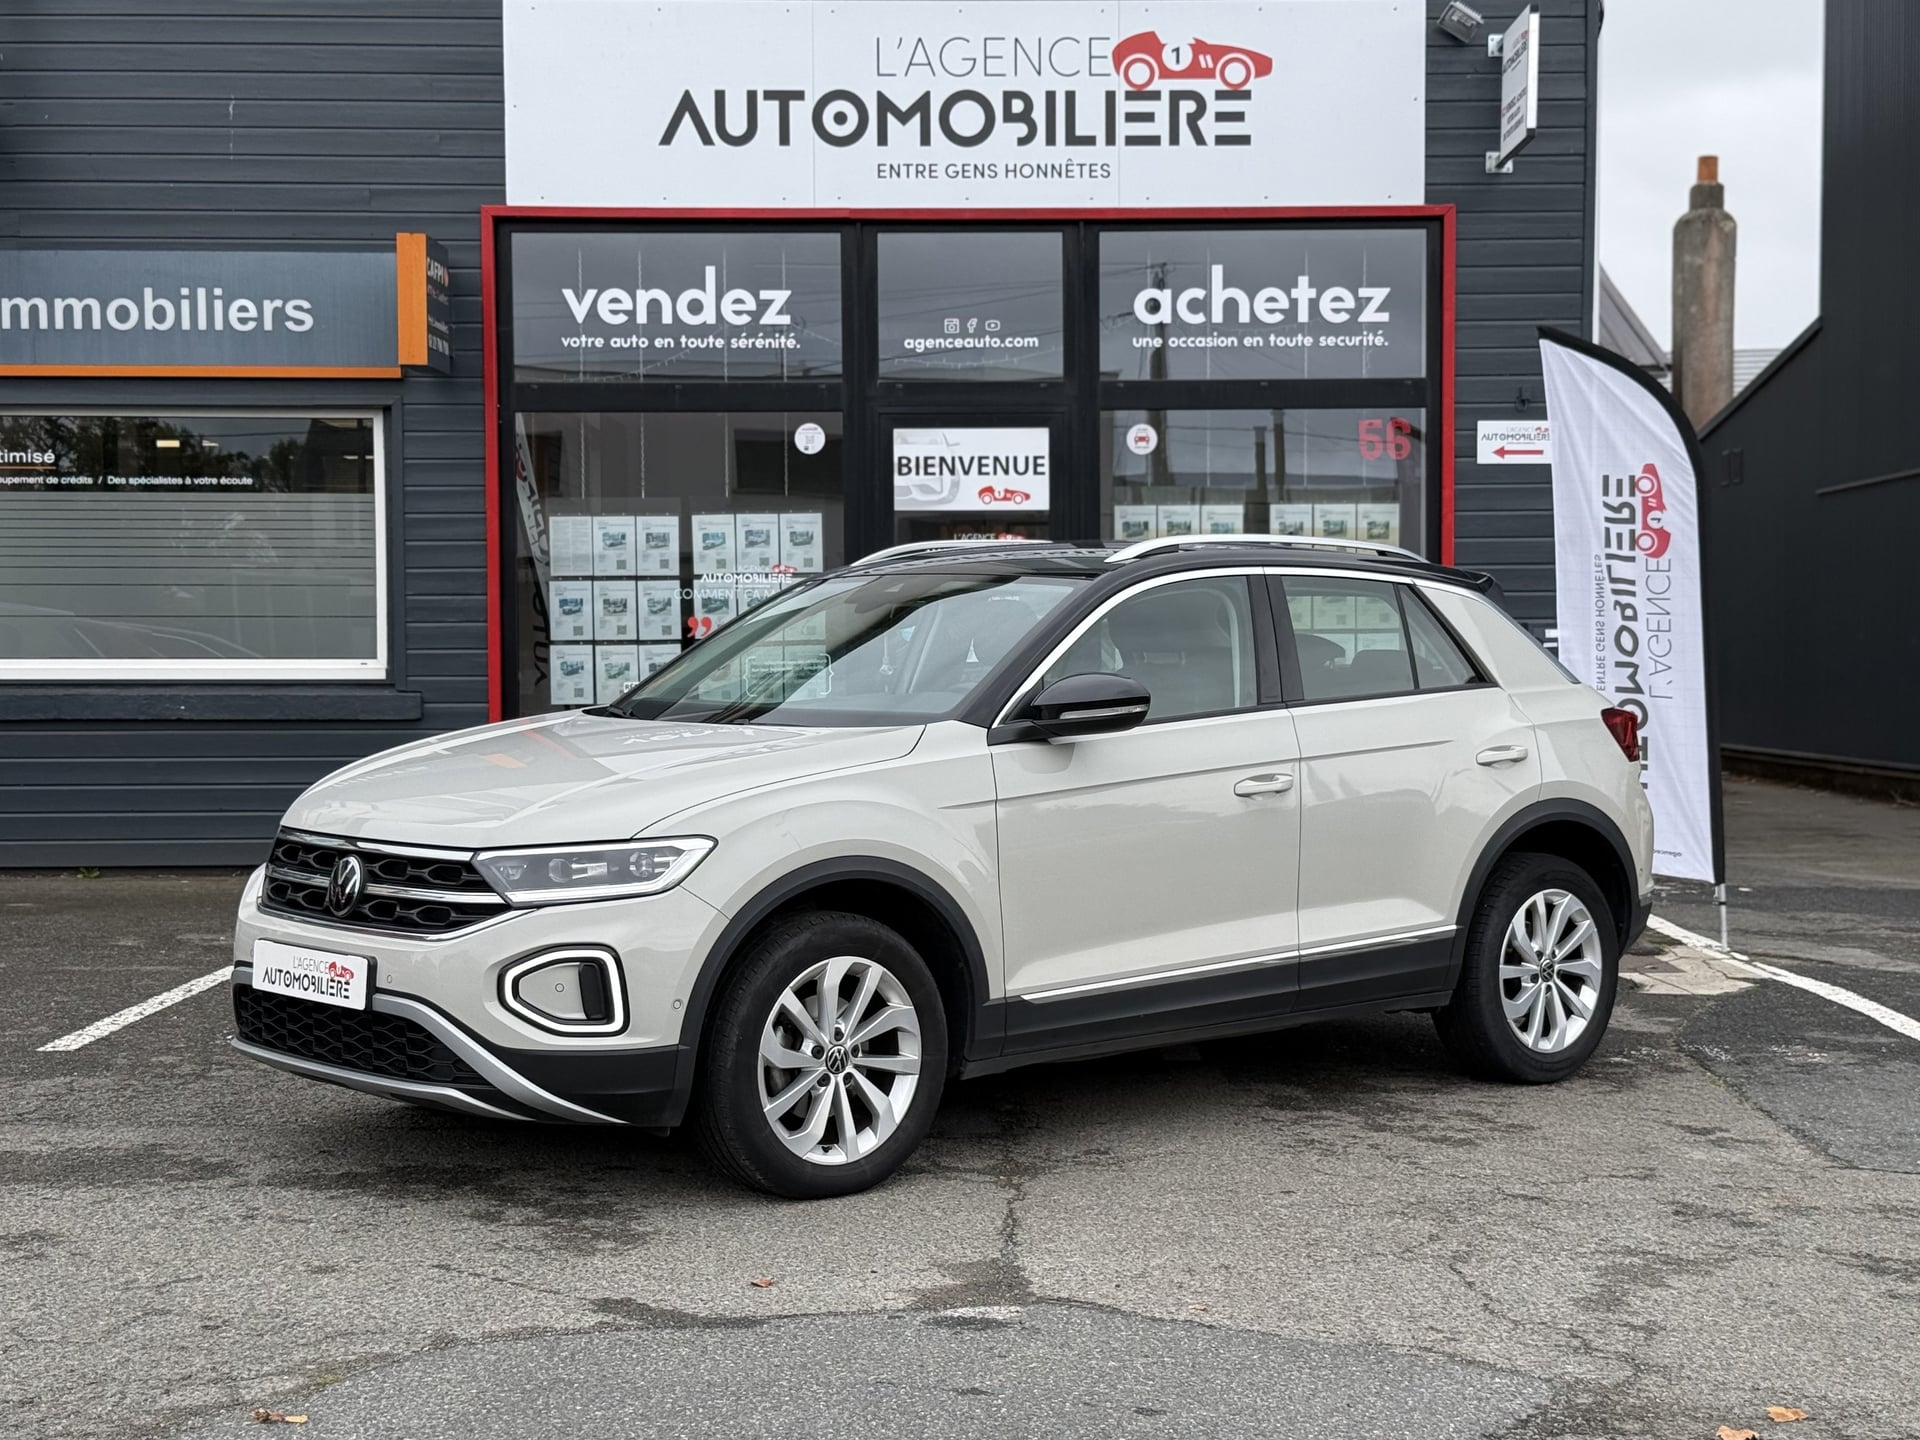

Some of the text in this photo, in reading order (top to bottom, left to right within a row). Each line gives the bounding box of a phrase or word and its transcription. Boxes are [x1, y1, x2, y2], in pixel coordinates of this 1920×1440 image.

[876, 36, 1113, 78] L'AGENCE
[1171, 46, 1180, 65] 1
[658, 89, 1252, 147] AUTOMOBILIERE
[876, 158, 1111, 179] ENTRE GENS HONNÊTES
[562, 265, 792, 325] vendez
[1133, 264, 1391, 325] achetez
[1, 287, 314, 332] mmobiliers
[561, 332, 800, 348] votre auto en toute sérénité.
[903, 335, 1039, 352] agenceauto.com
[1132, 330, 1389, 347] une occasion en toute securité.
[1358, 417, 1412, 460] 56
[0, 449, 55, 463] timisé
[896, 456, 1046, 476] BIENVENUE
[46, 475, 59, 484] de
[60, 475, 94, 484] crédits
[107, 475, 127, 484] Des
[128, 475, 183, 486] spécialistes
[185, 475, 192, 484] à
[193, 476, 218, 484] votre
[220, 475, 253, 484] écoute
[701, 573, 793, 583] AUTOMOBILIERE
[673, 589, 740, 599] COMMENT
[293, 955, 329, 975] L'AGENCE
[263, 967, 351, 999] AUTOMOBILIERE
